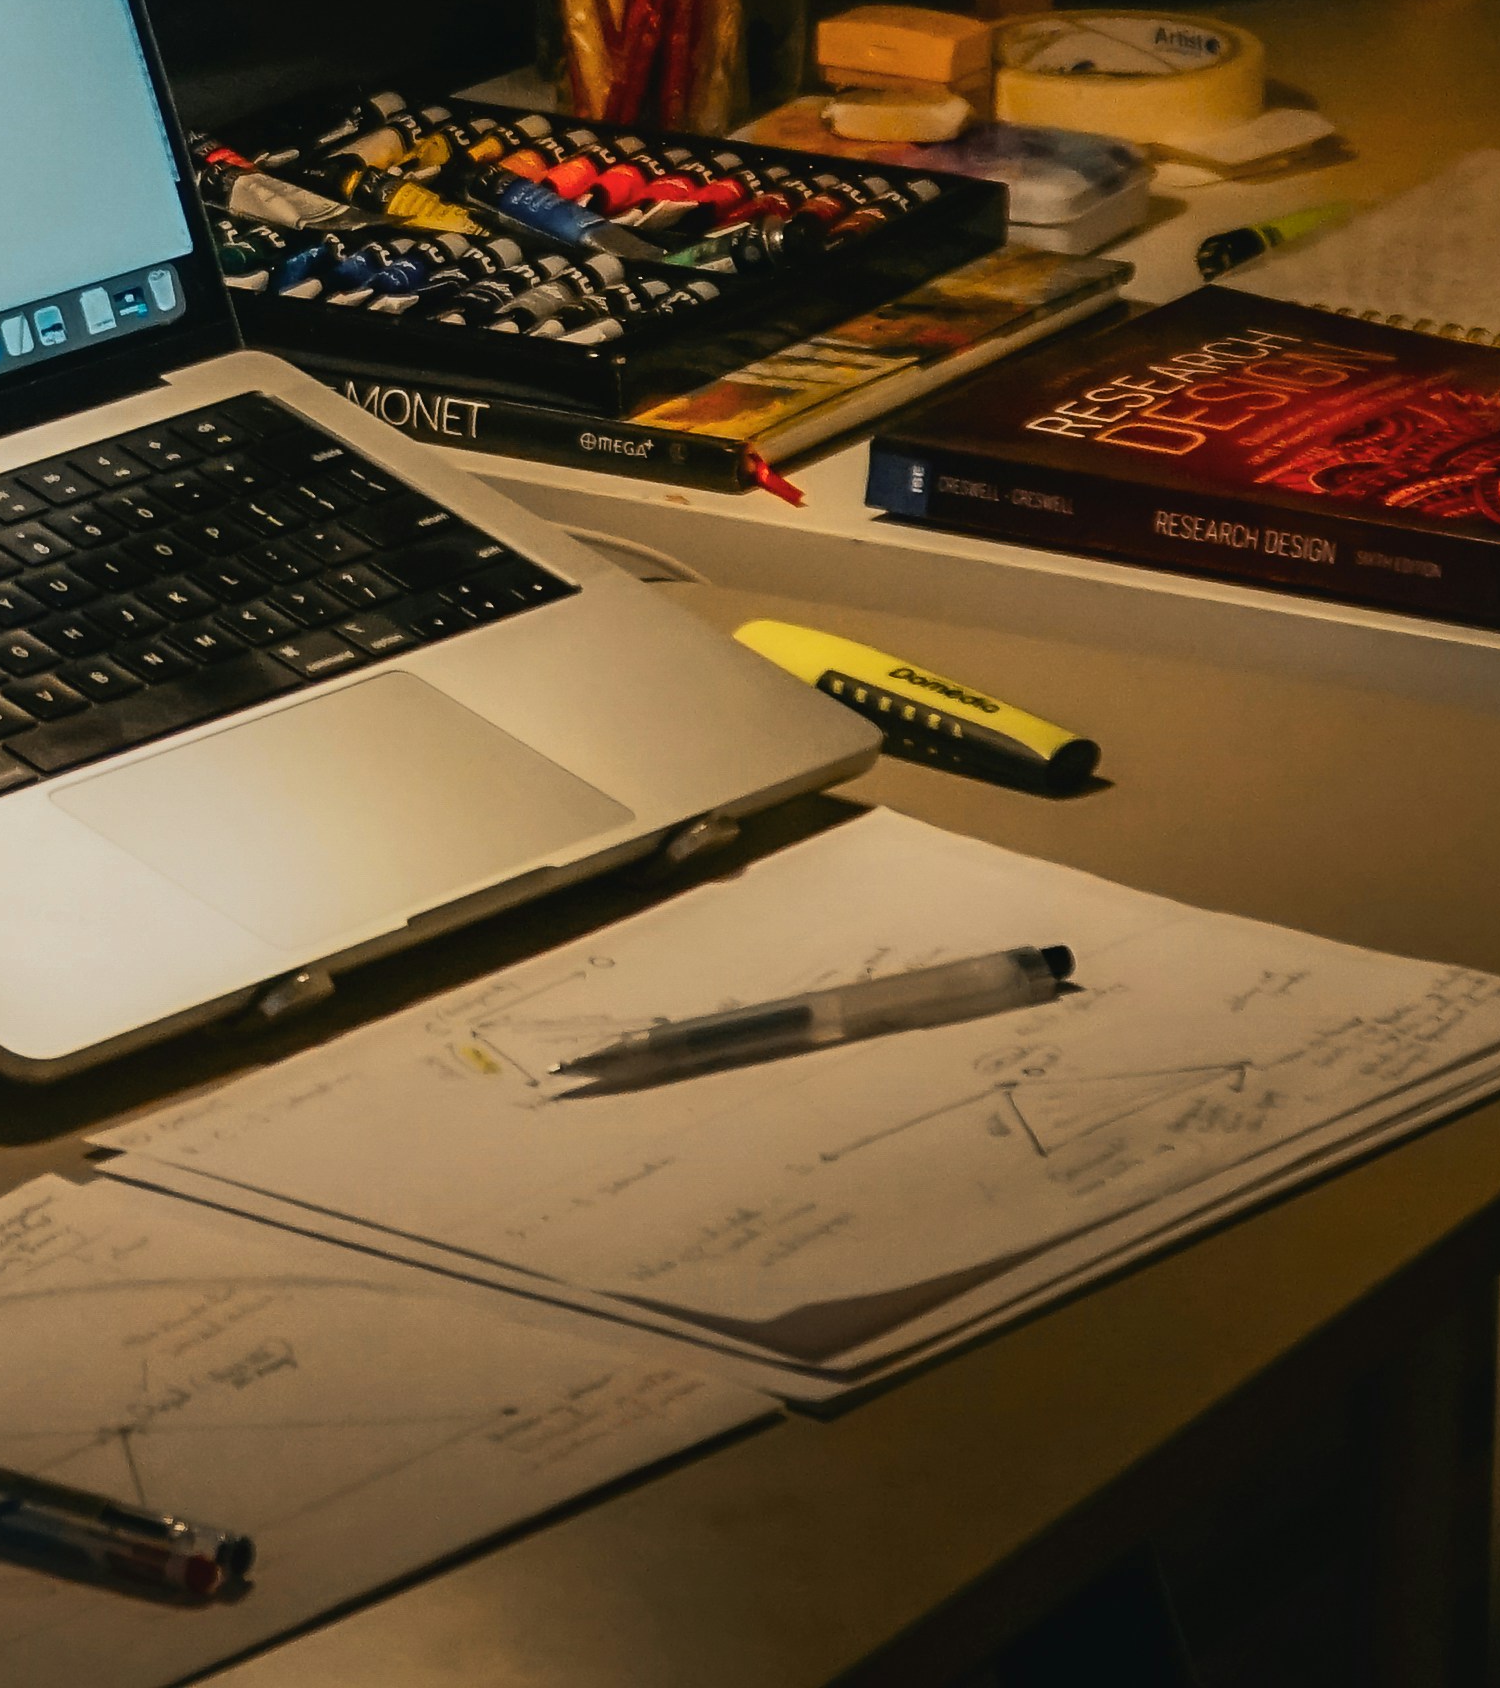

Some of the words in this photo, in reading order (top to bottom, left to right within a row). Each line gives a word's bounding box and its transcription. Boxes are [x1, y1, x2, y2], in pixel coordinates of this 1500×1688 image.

[345, 379, 491, 440] MONET
[1024, 327, 1303, 439] RESEARCH
[1092, 340, 1398, 456] DESIGN
[1153, 509, 1260, 552] RESEARCH
[1263, 530, 1337, 565] DESIGN
